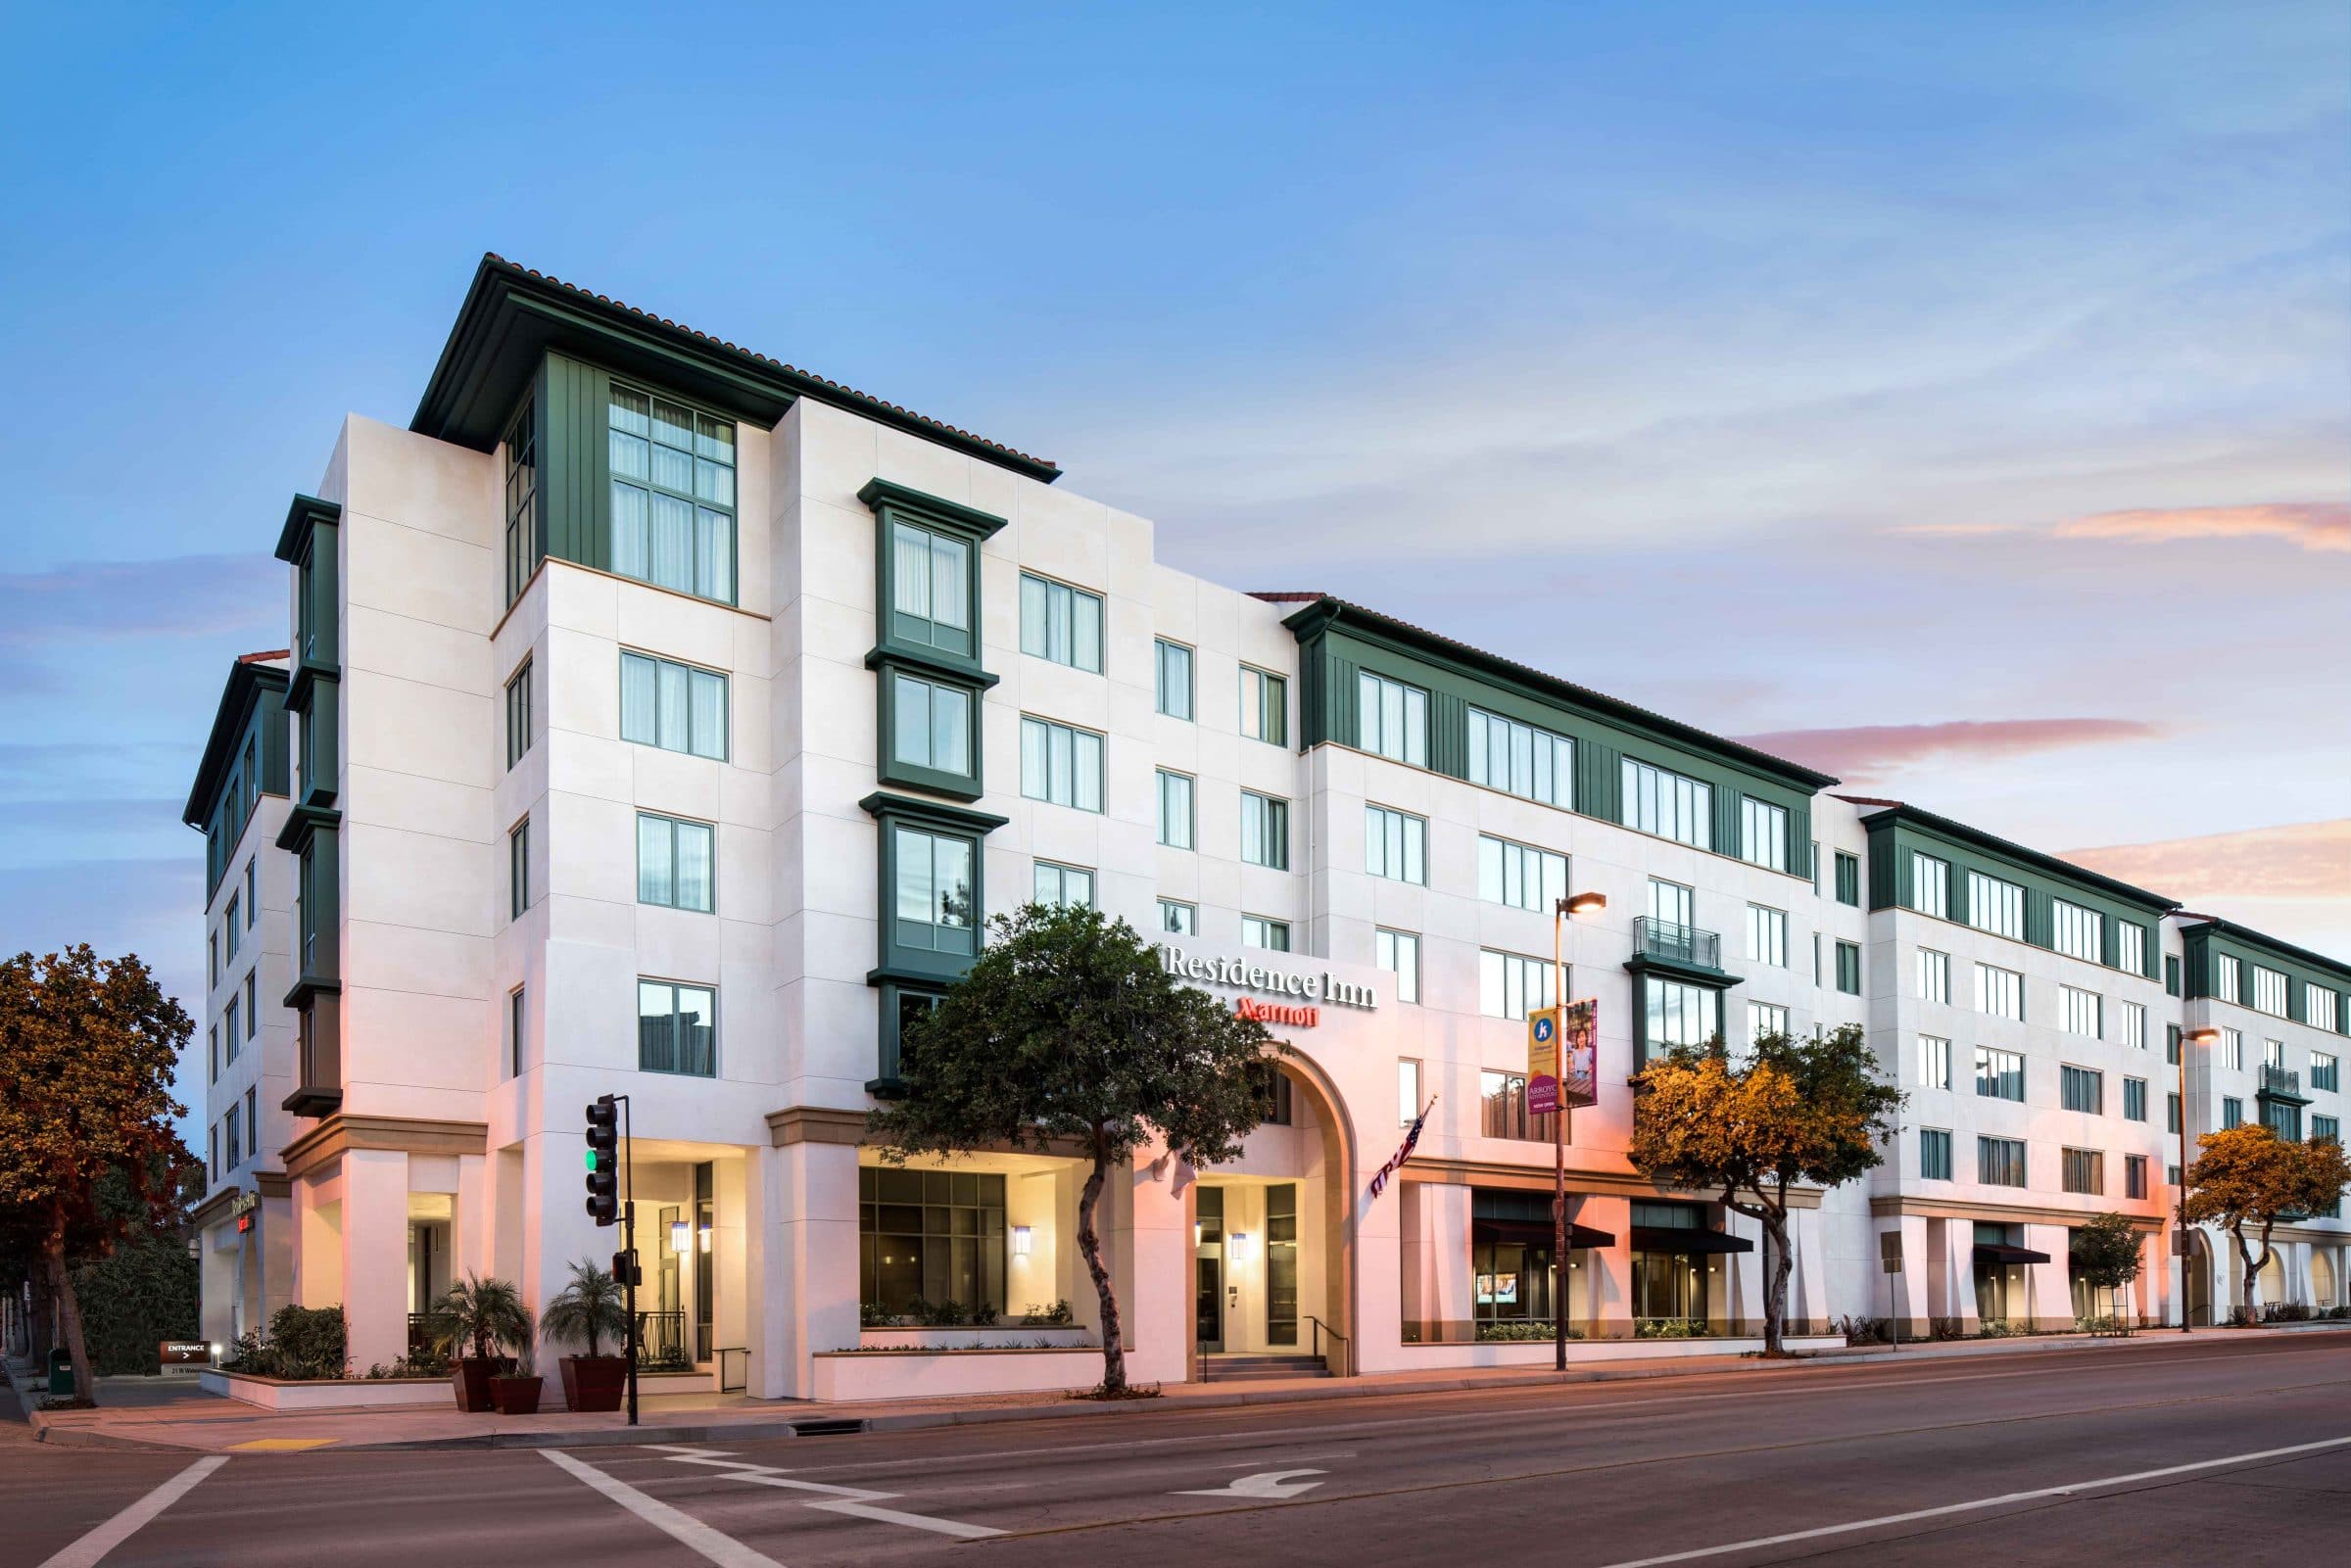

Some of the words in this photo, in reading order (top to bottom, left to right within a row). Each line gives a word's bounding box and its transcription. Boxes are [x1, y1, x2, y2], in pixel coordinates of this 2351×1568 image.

[1167, 946, 1318, 997] Residence
[1324, 972, 1378, 1009] Inn
[1234, 997, 1319, 1027] Marriott
